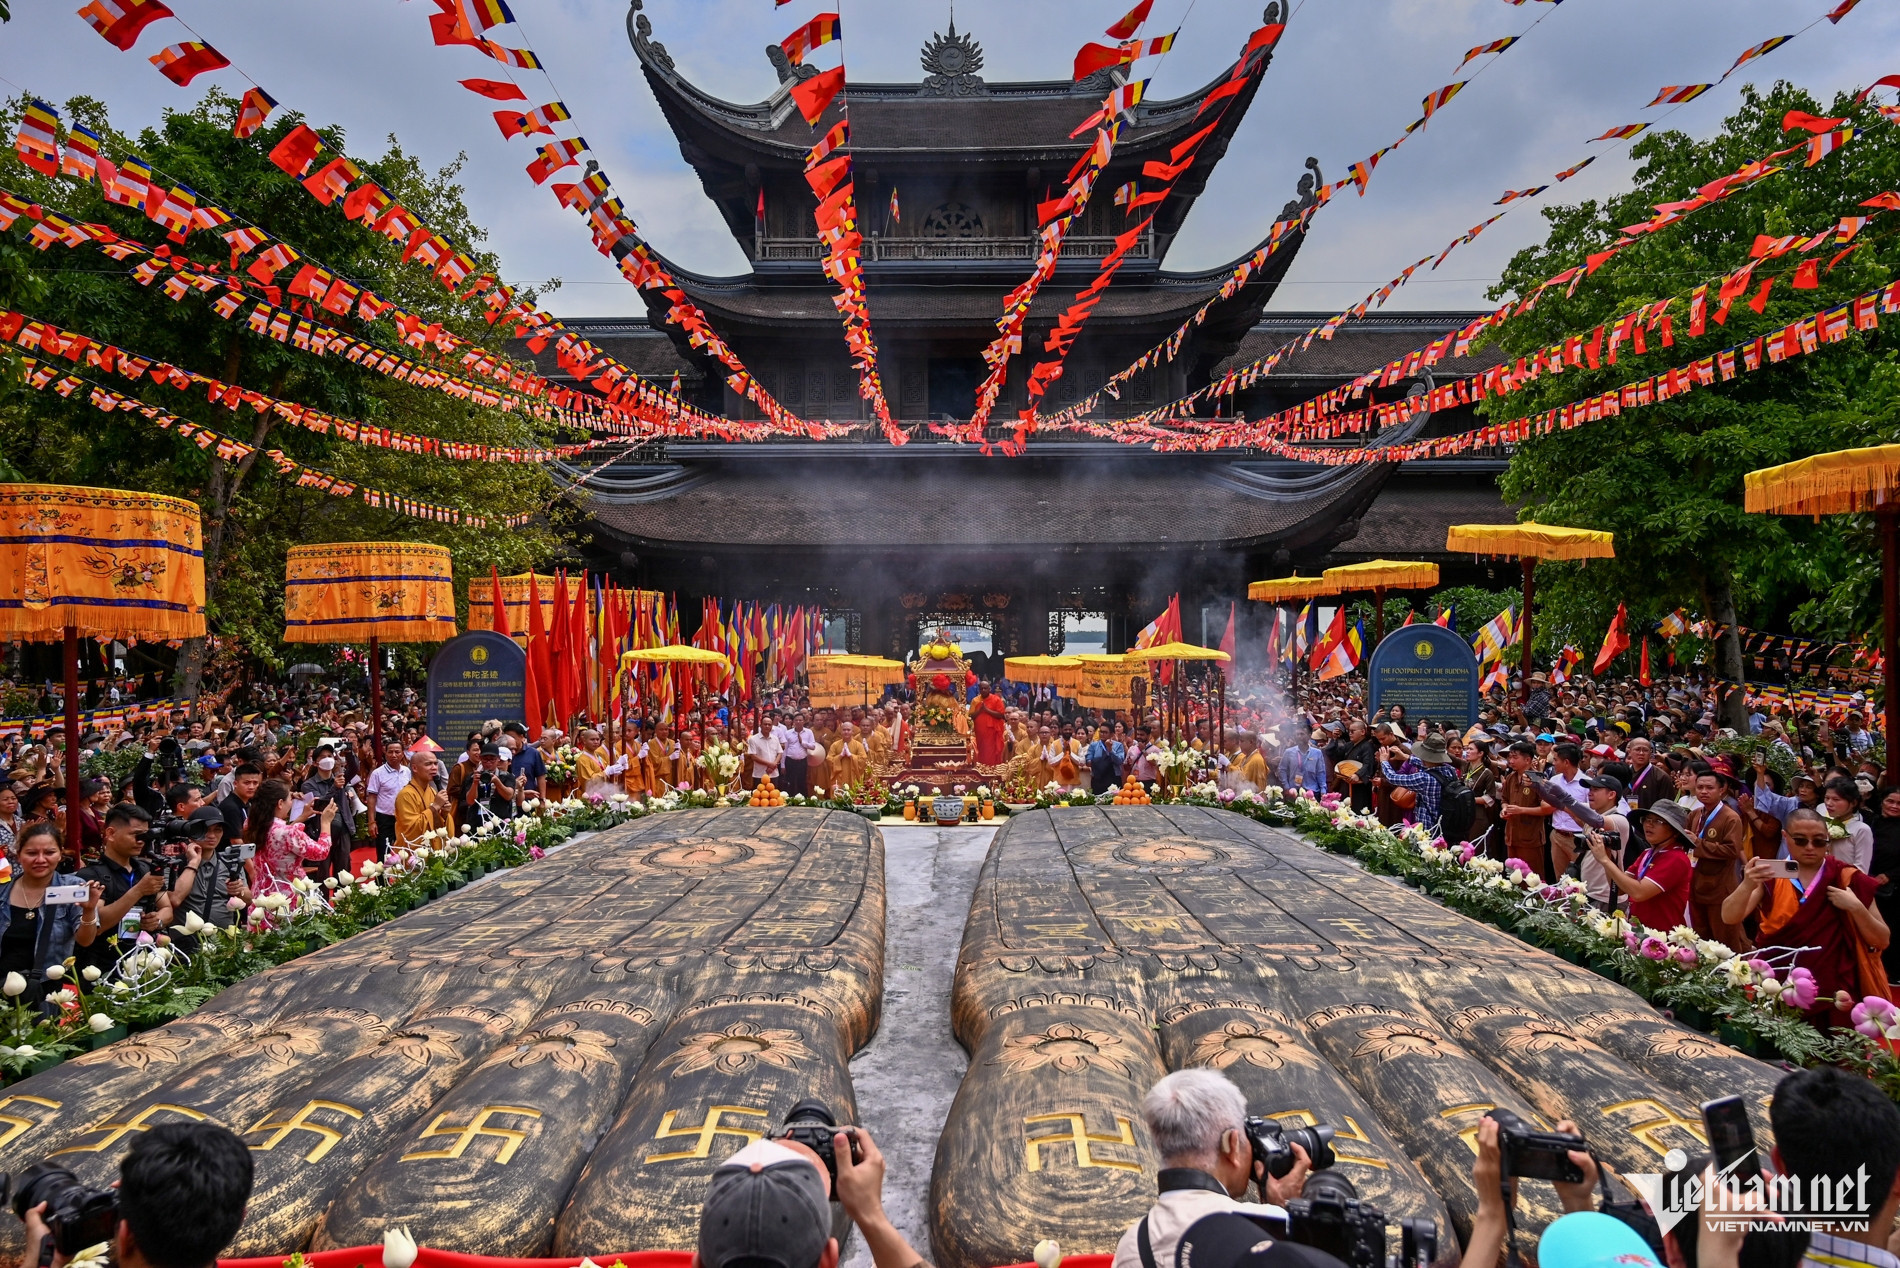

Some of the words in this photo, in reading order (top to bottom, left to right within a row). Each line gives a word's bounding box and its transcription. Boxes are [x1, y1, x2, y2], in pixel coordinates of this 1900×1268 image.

[1381, 667, 1390, 675] THE
[1392, 667, 1422, 675] FOOTPRINT
[1424, 667, 1432, 675] OF
[1433, 667, 1443, 675] THE
[1445, 667, 1469, 675] BUDDHA
